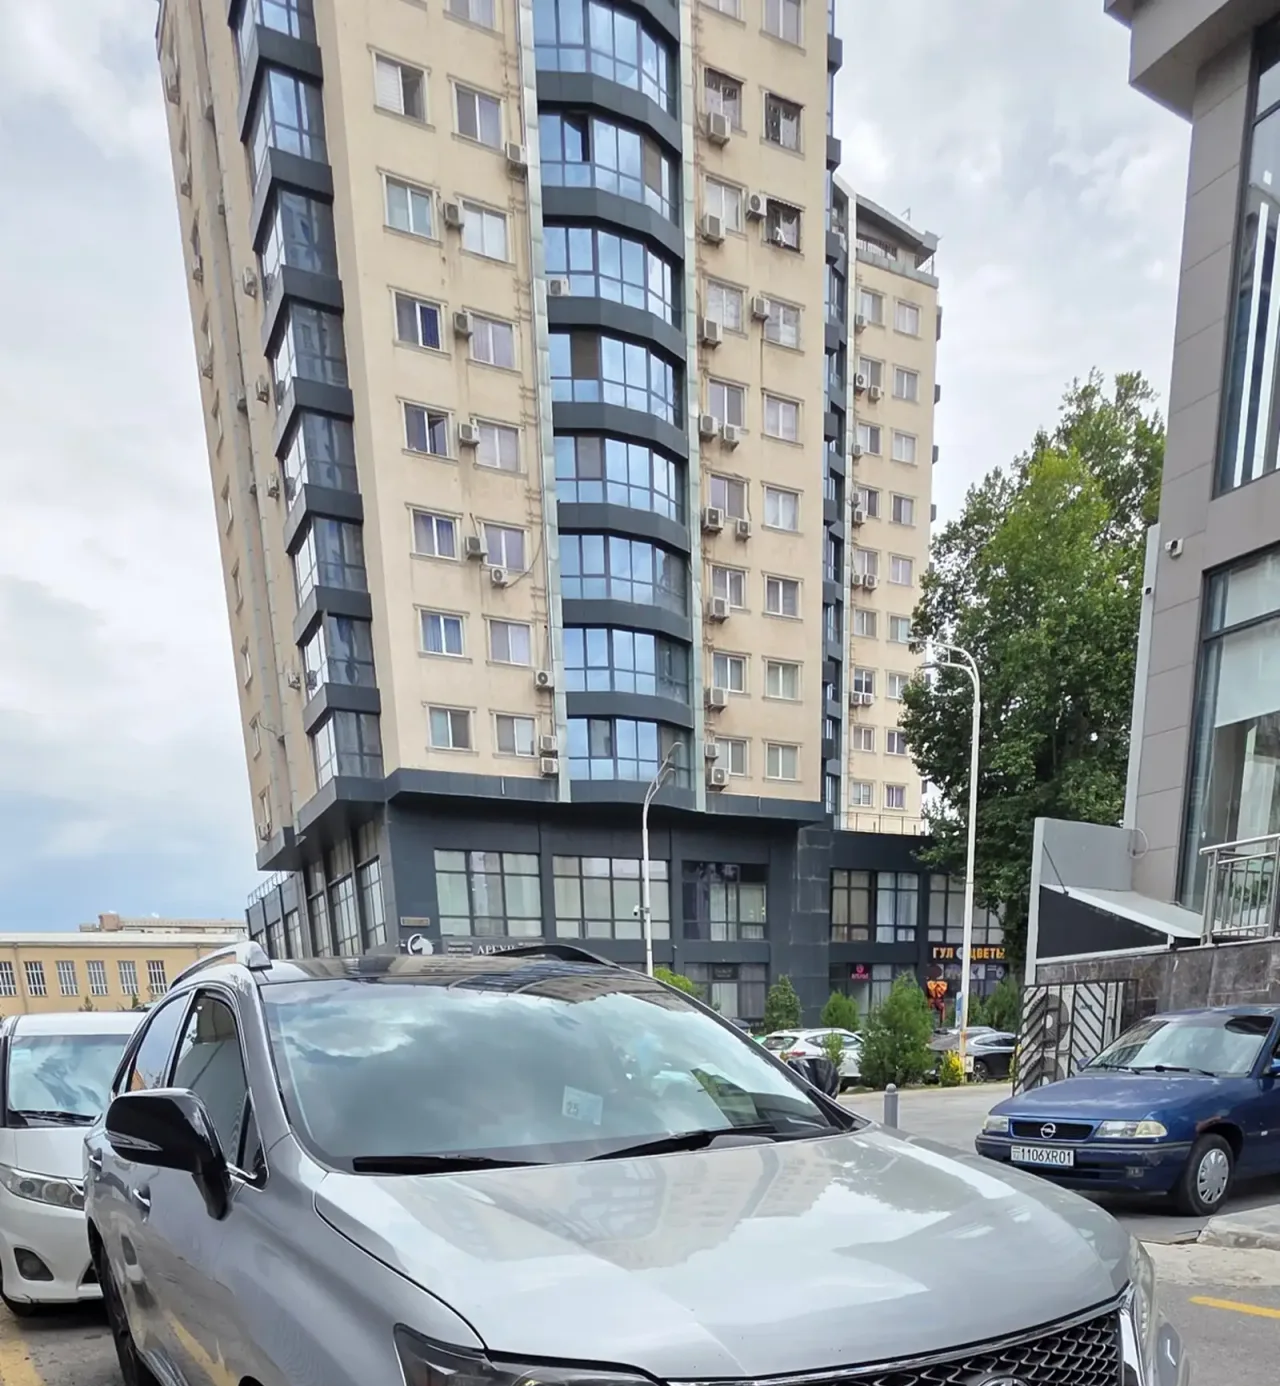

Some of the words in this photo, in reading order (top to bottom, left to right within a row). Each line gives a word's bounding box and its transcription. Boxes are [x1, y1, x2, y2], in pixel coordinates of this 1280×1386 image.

[932, 947, 954, 959] ГУЛ
[968, 947, 1006, 960] ЦВЕТЫ
[1021, 1147, 1072, 1165] 1106XR01
